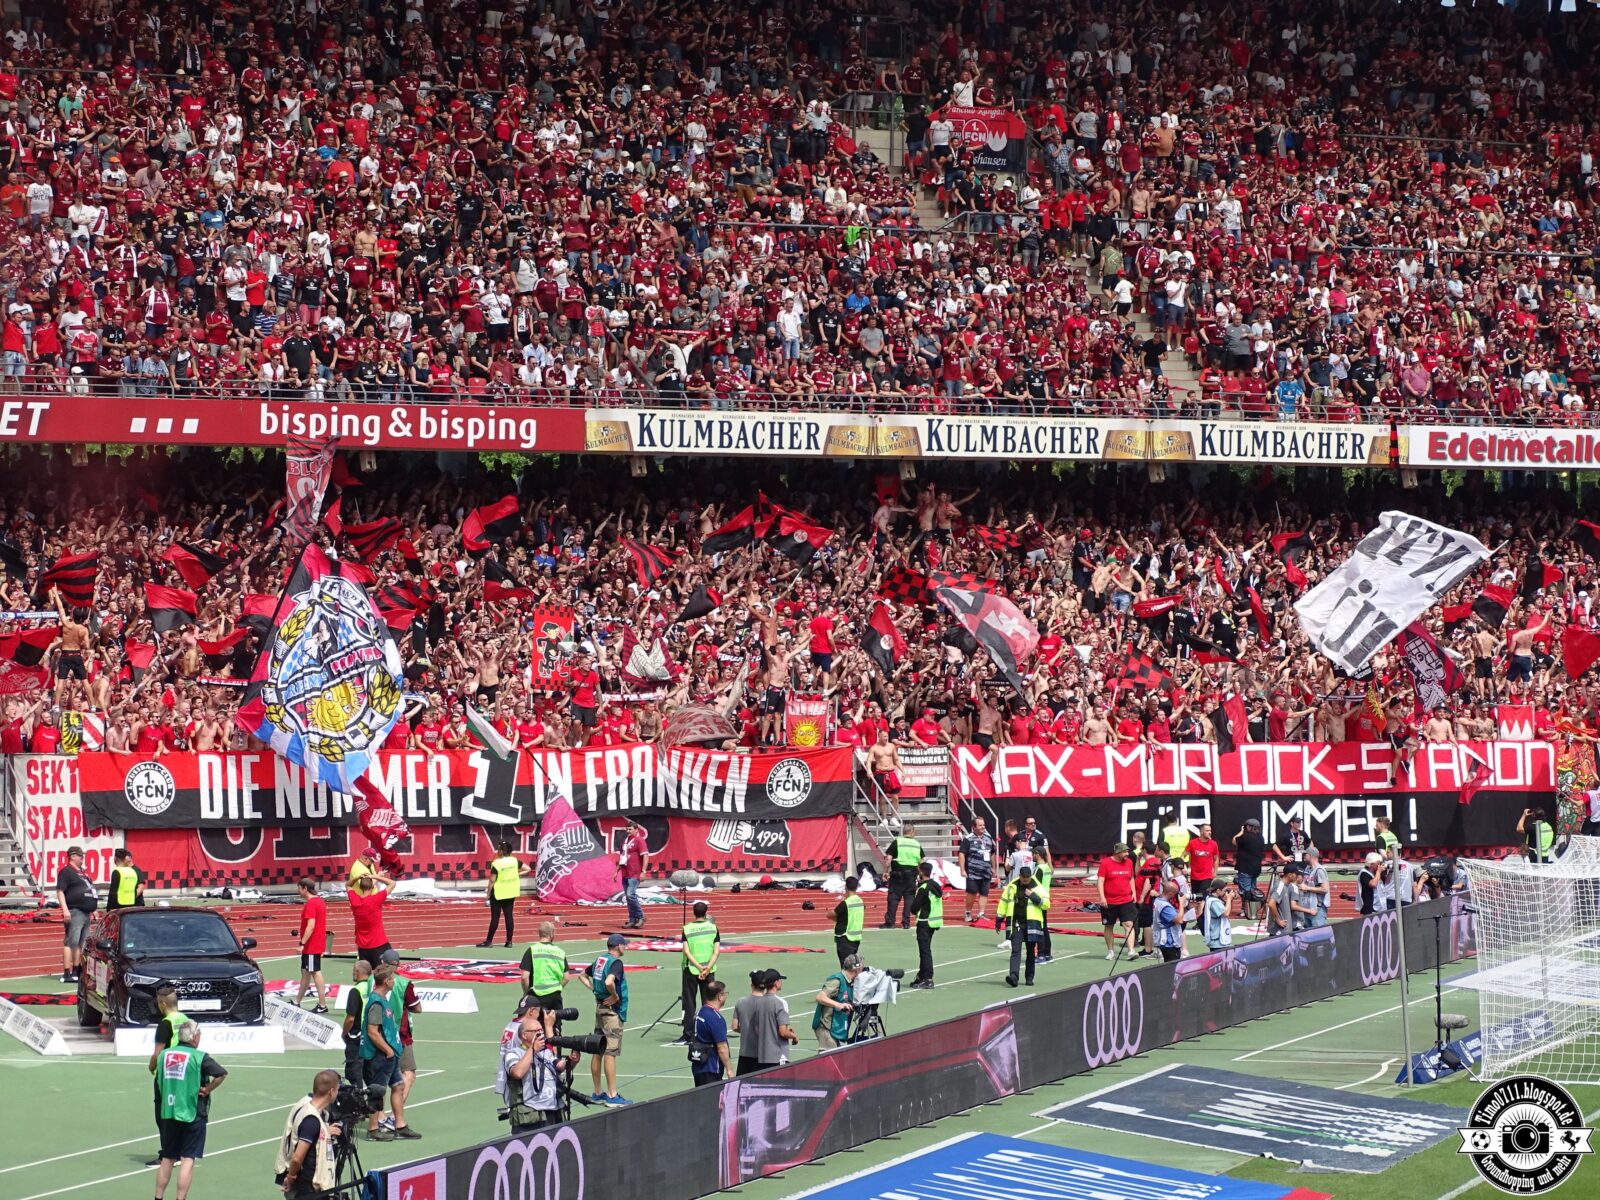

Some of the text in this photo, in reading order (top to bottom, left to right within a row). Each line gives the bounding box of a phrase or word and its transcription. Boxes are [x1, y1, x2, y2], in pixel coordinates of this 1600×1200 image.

[260, 403, 537, 449] bisping & bisping
[637, 412, 821, 451] KULMBACHER
[925, 417, 1100, 455] KULMBACHER
[1199, 422, 1366, 461] KULMBACHER
[144, 771, 155, 785] 1.
[198, 753, 263, 820] DIE
[533, 751, 575, 815] IN
[584, 745, 752, 813] FRANKEN
[775, 778, 802, 793] FCN
[785, 766, 794, 779] 1.
[136, 784, 165, 799] FCN
[756, 830, 786, 848] 1994
